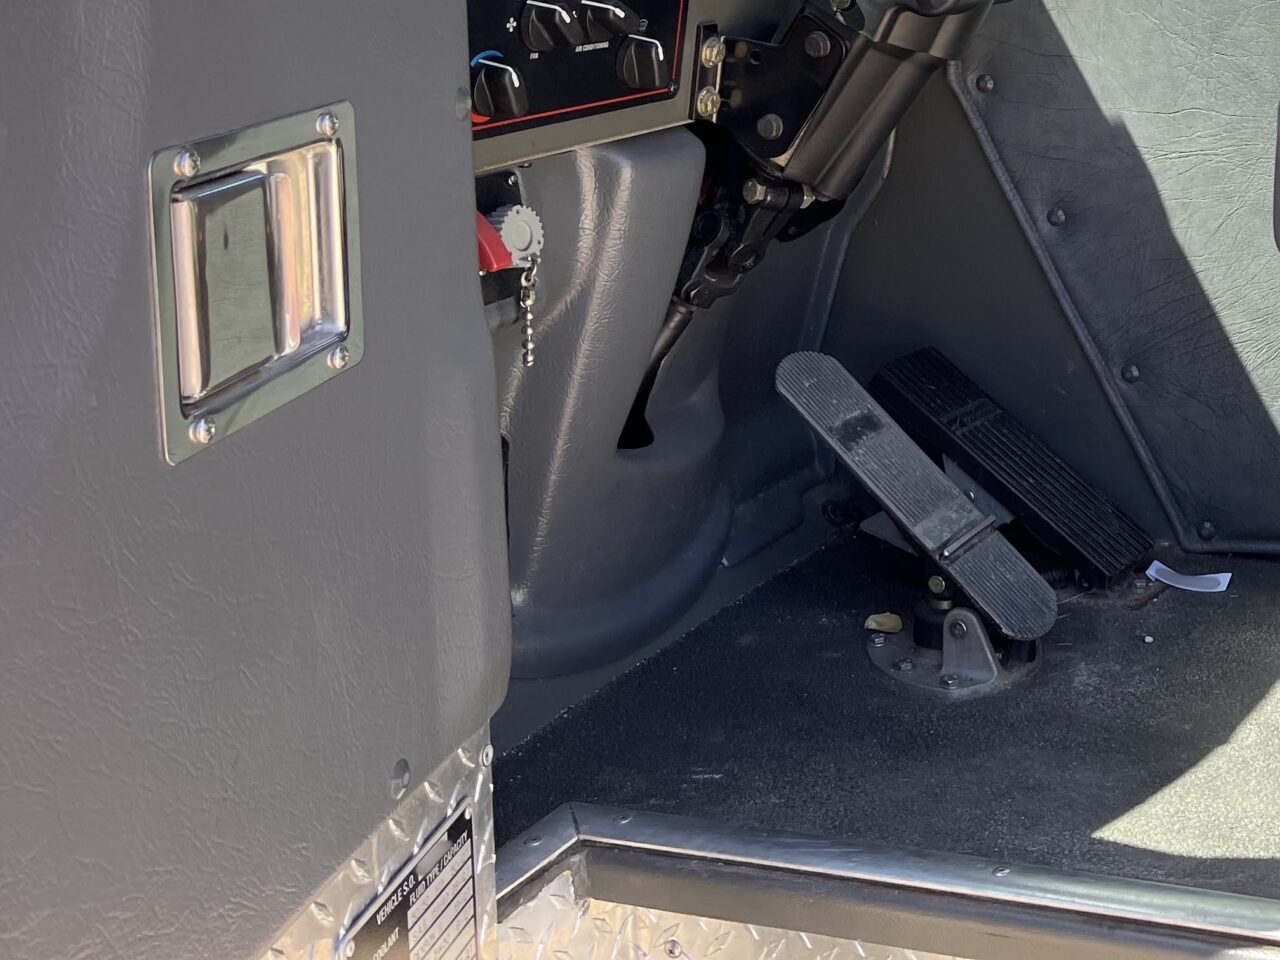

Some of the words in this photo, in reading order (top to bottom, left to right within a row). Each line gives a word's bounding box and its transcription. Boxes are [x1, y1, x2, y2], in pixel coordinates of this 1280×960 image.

[583, 41, 609, 51] CONDITIONING
[409, 881, 426, 907] FLUID
[426, 864, 440, 886] TYPE
[443, 830, 468, 866] CAPACITY
[376, 888, 403, 925] VEHICLE
[403, 874, 416, 895] S.O.
